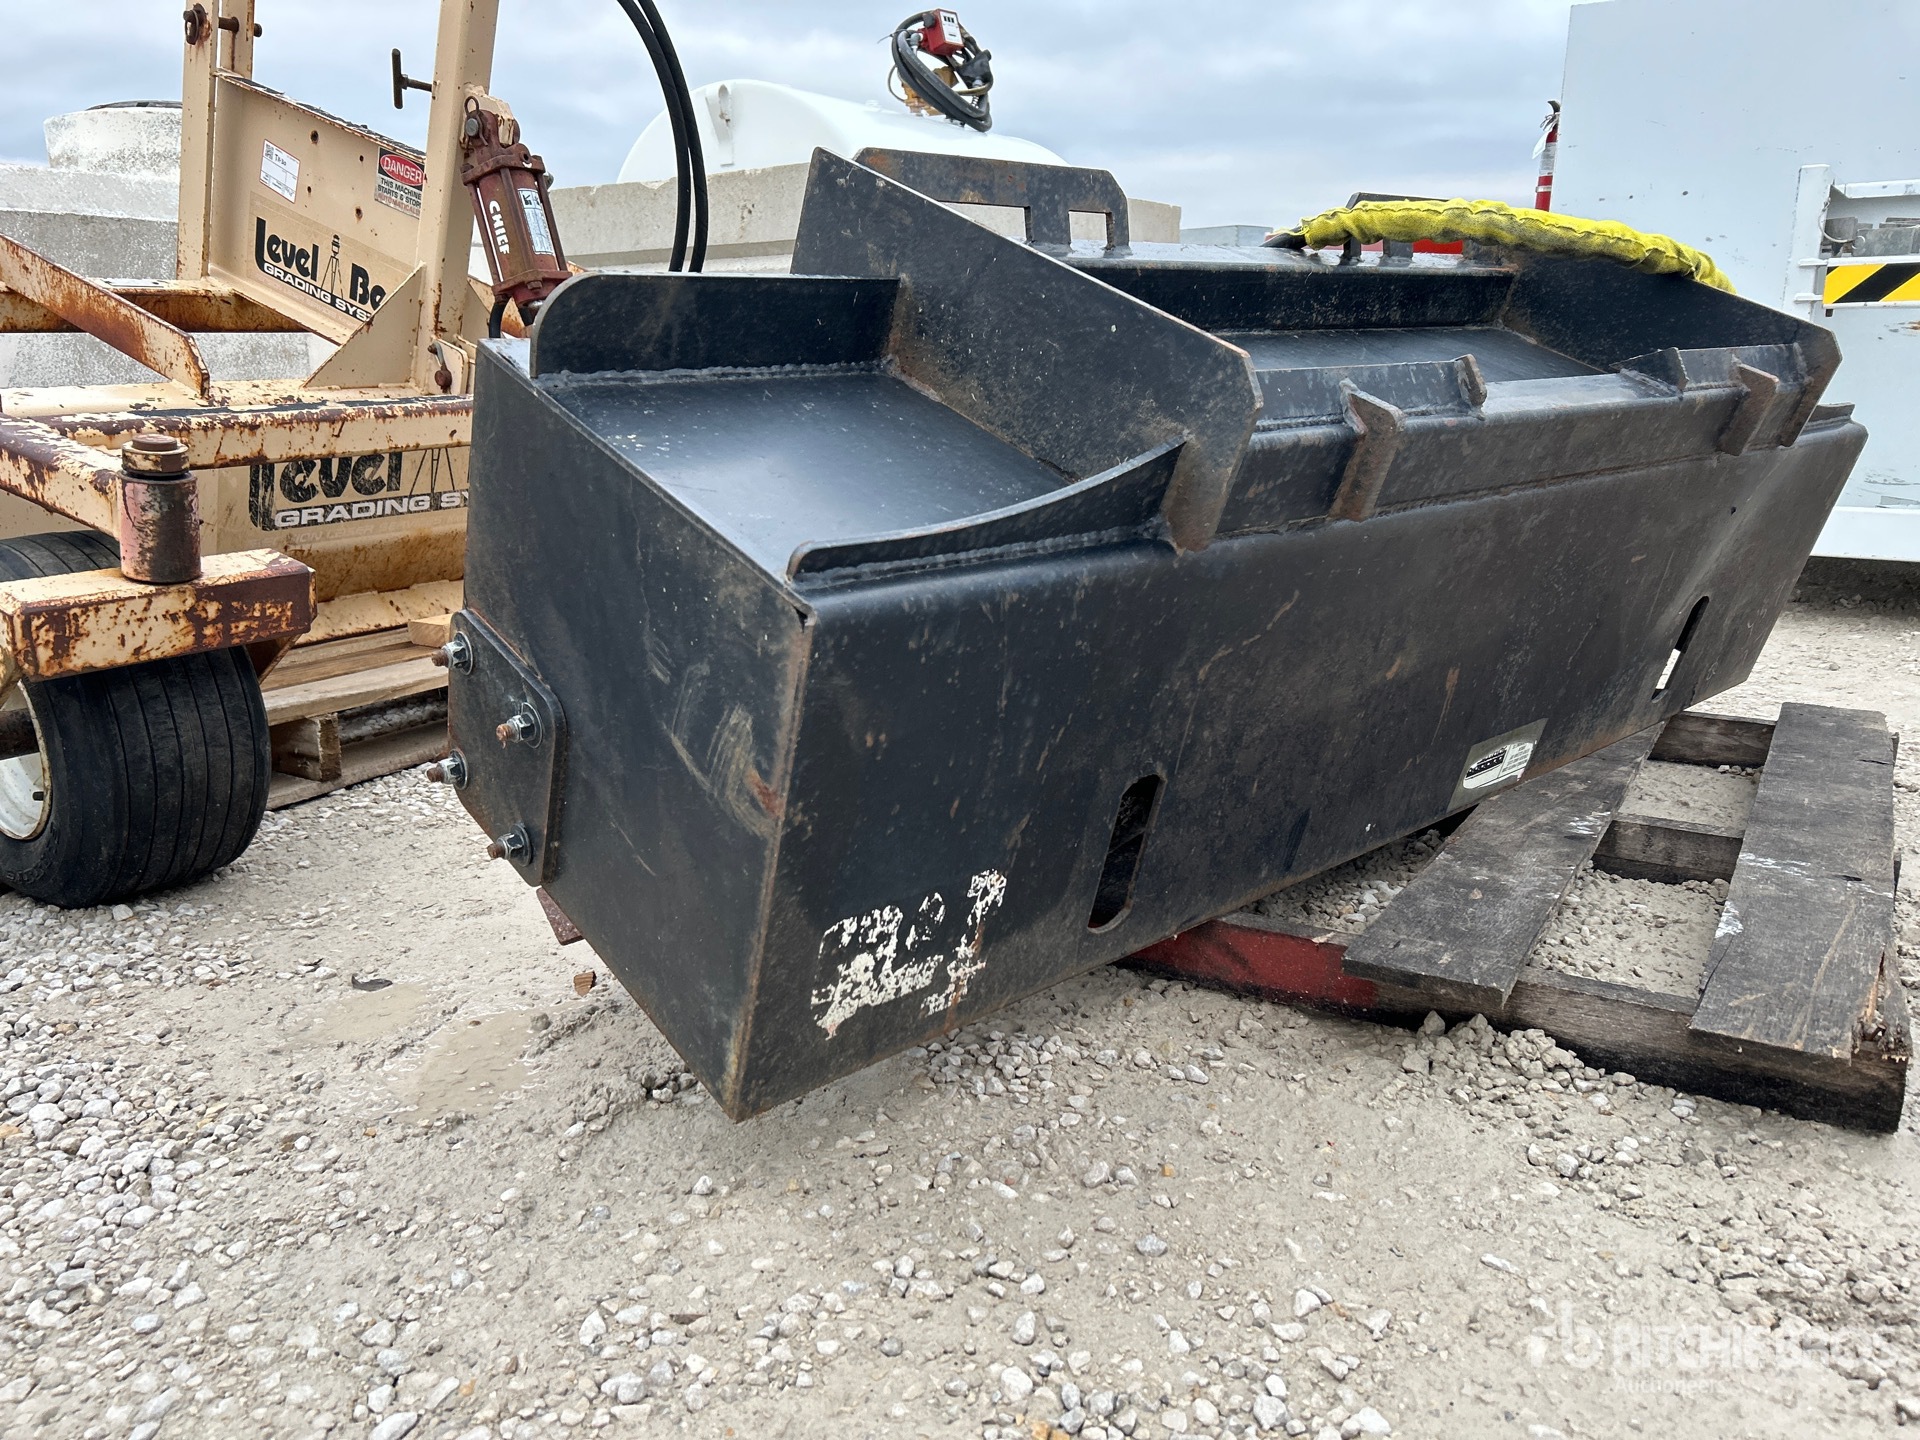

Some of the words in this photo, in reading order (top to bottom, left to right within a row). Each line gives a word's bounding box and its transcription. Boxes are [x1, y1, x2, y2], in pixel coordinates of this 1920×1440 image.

[384, 157, 422, 183] DANGER
[378, 184, 399, 199] STARTS
[399, 193, 405, 201] &
[405, 196, 421, 209] STOP
[381, 177, 394, 189] THIS
[395, 183, 422, 200] MACHINE
[488, 200, 510, 255] CHIEF
[254, 216, 320, 282] Level
[263, 262, 333, 305] GRADING
[273, 494, 431, 529] GRADING
